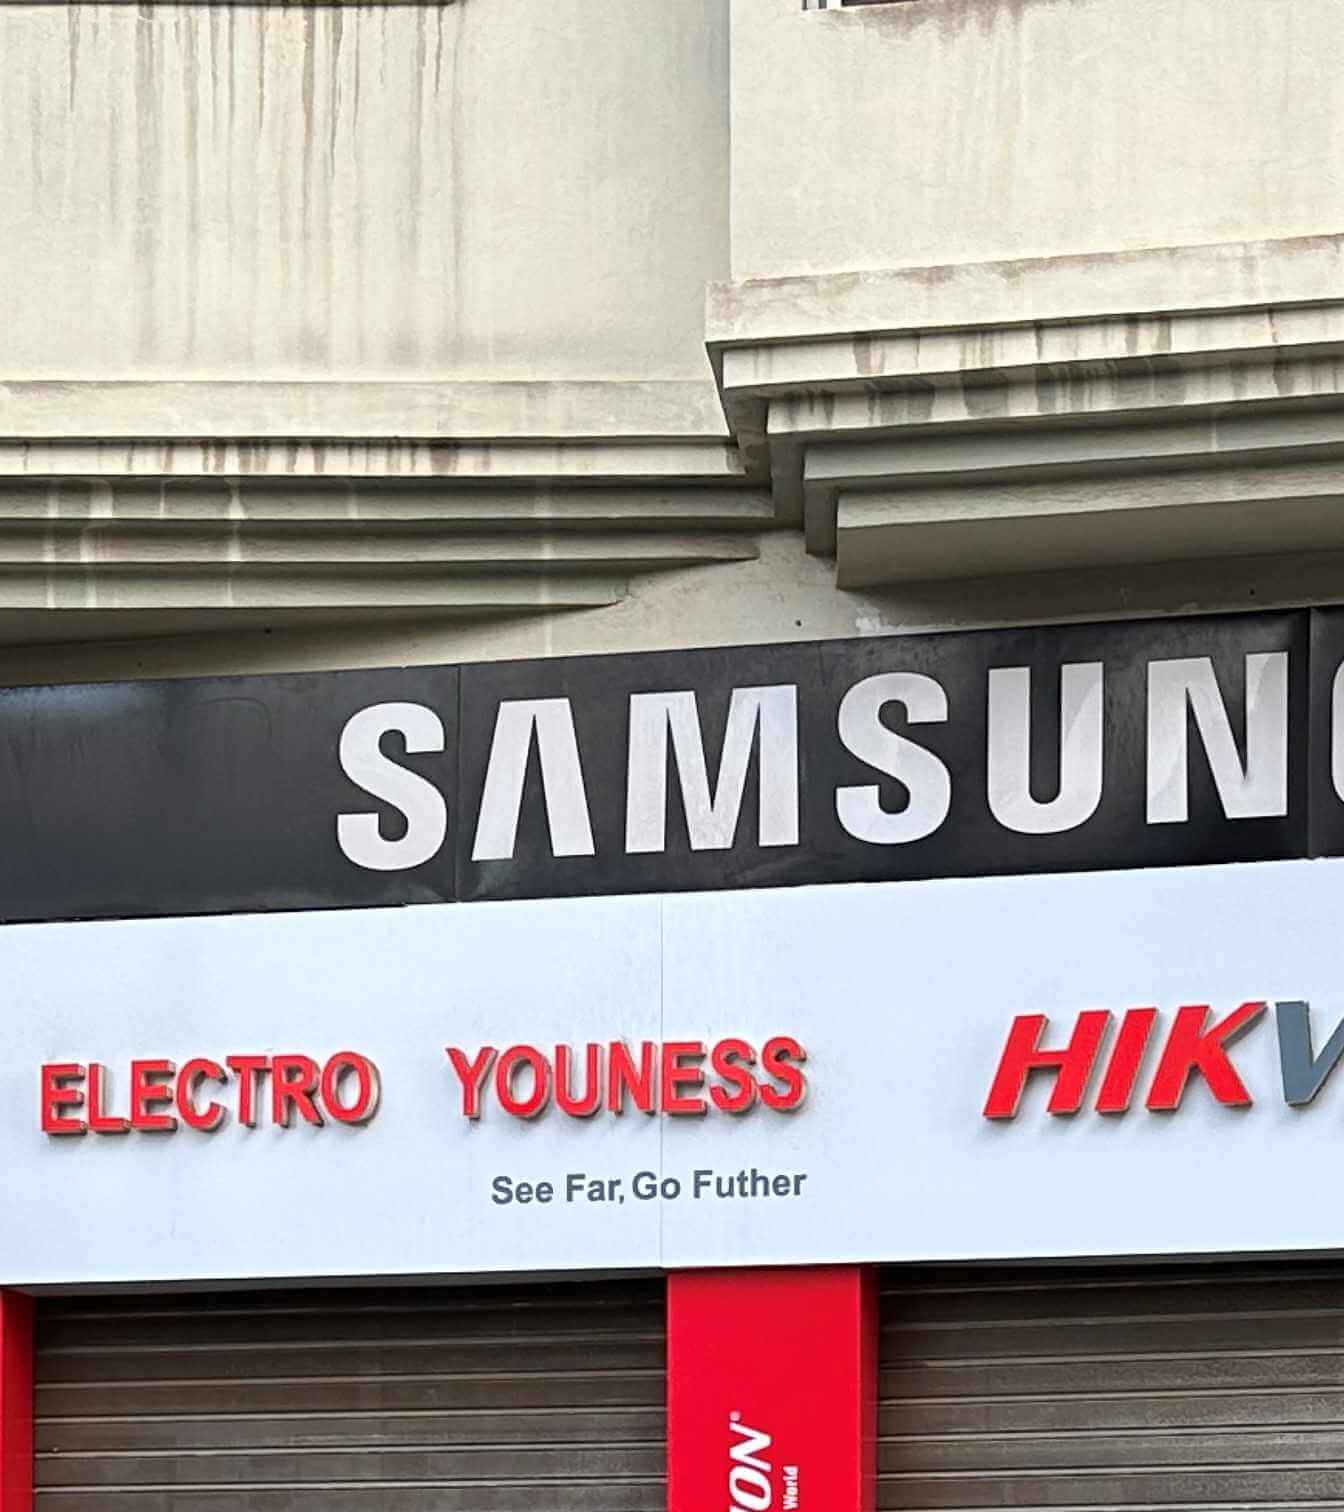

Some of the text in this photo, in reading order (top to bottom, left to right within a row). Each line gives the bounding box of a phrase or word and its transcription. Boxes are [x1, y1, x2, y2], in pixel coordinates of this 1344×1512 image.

[41, 1036, 807, 1134] ELECTRO YOUNESS
[492, 1168, 807, 1204] See Far, Go Futher
[782, 1466, 798, 1510] World
